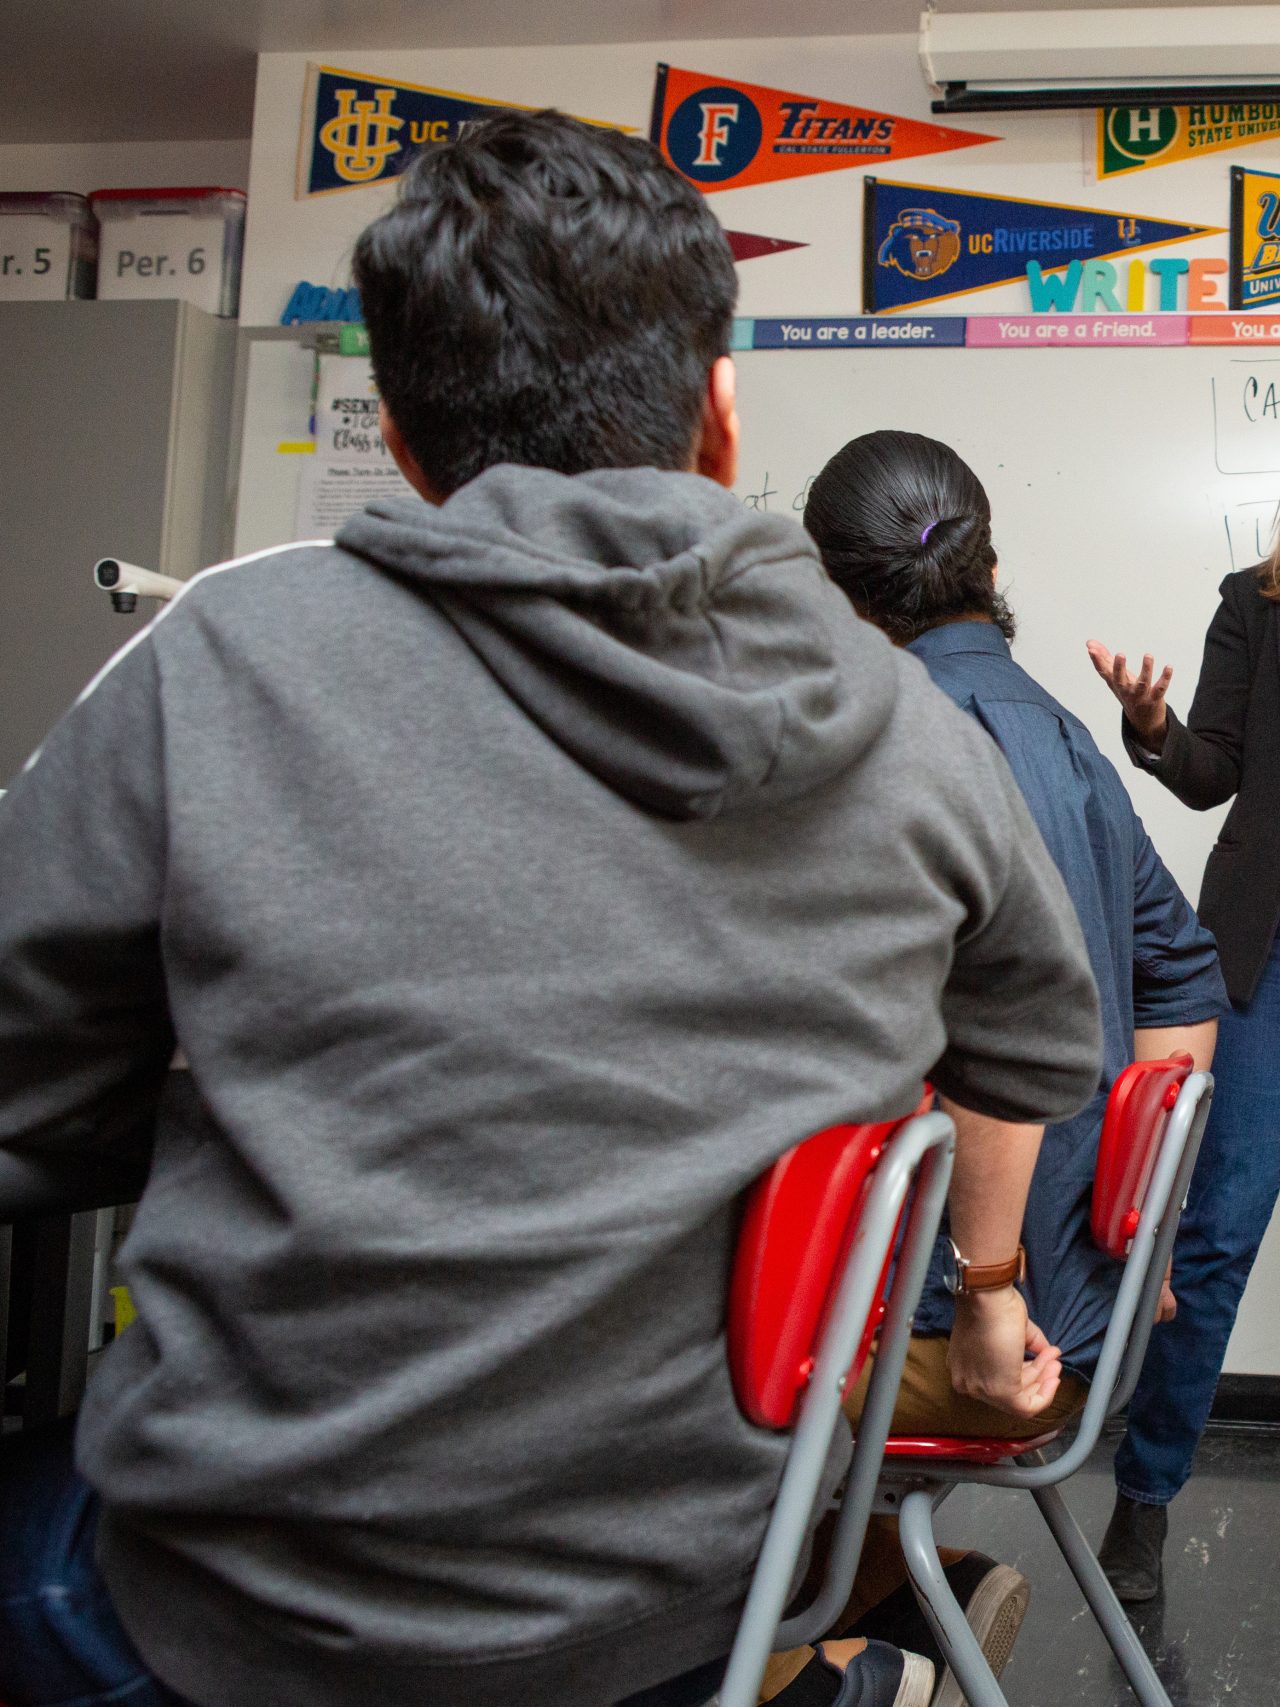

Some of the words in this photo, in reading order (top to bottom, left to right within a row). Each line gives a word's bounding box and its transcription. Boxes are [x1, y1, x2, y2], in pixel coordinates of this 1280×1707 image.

[409, 120, 450, 143] UC
[692, 103, 739, 165] F
[1128, 107, 1162, 142] H
[1188, 125, 1233, 148] STATE
[802, 145, 829, 154] STATE
[832, 145, 886, 154] FULLERTON
[3, 254, 22, 275] r.
[33, 248, 51, 275] 5
[116, 250, 176, 277] Per.
[188, 248, 206, 275] 6
[1026, 258, 1229, 313] WRITE
[780, 324, 812, 340] You
[816, 326, 849, 340] are
[854, 327, 867, 339] a
[872, 323, 935, 339] leader.
[999, 323, 1030, 338] You
[1036, 325, 1070, 338] are
[1075, 325, 1087, 338] a
[1091, 321, 1156, 338] friend.
[1232, 321, 1265, 338] You
